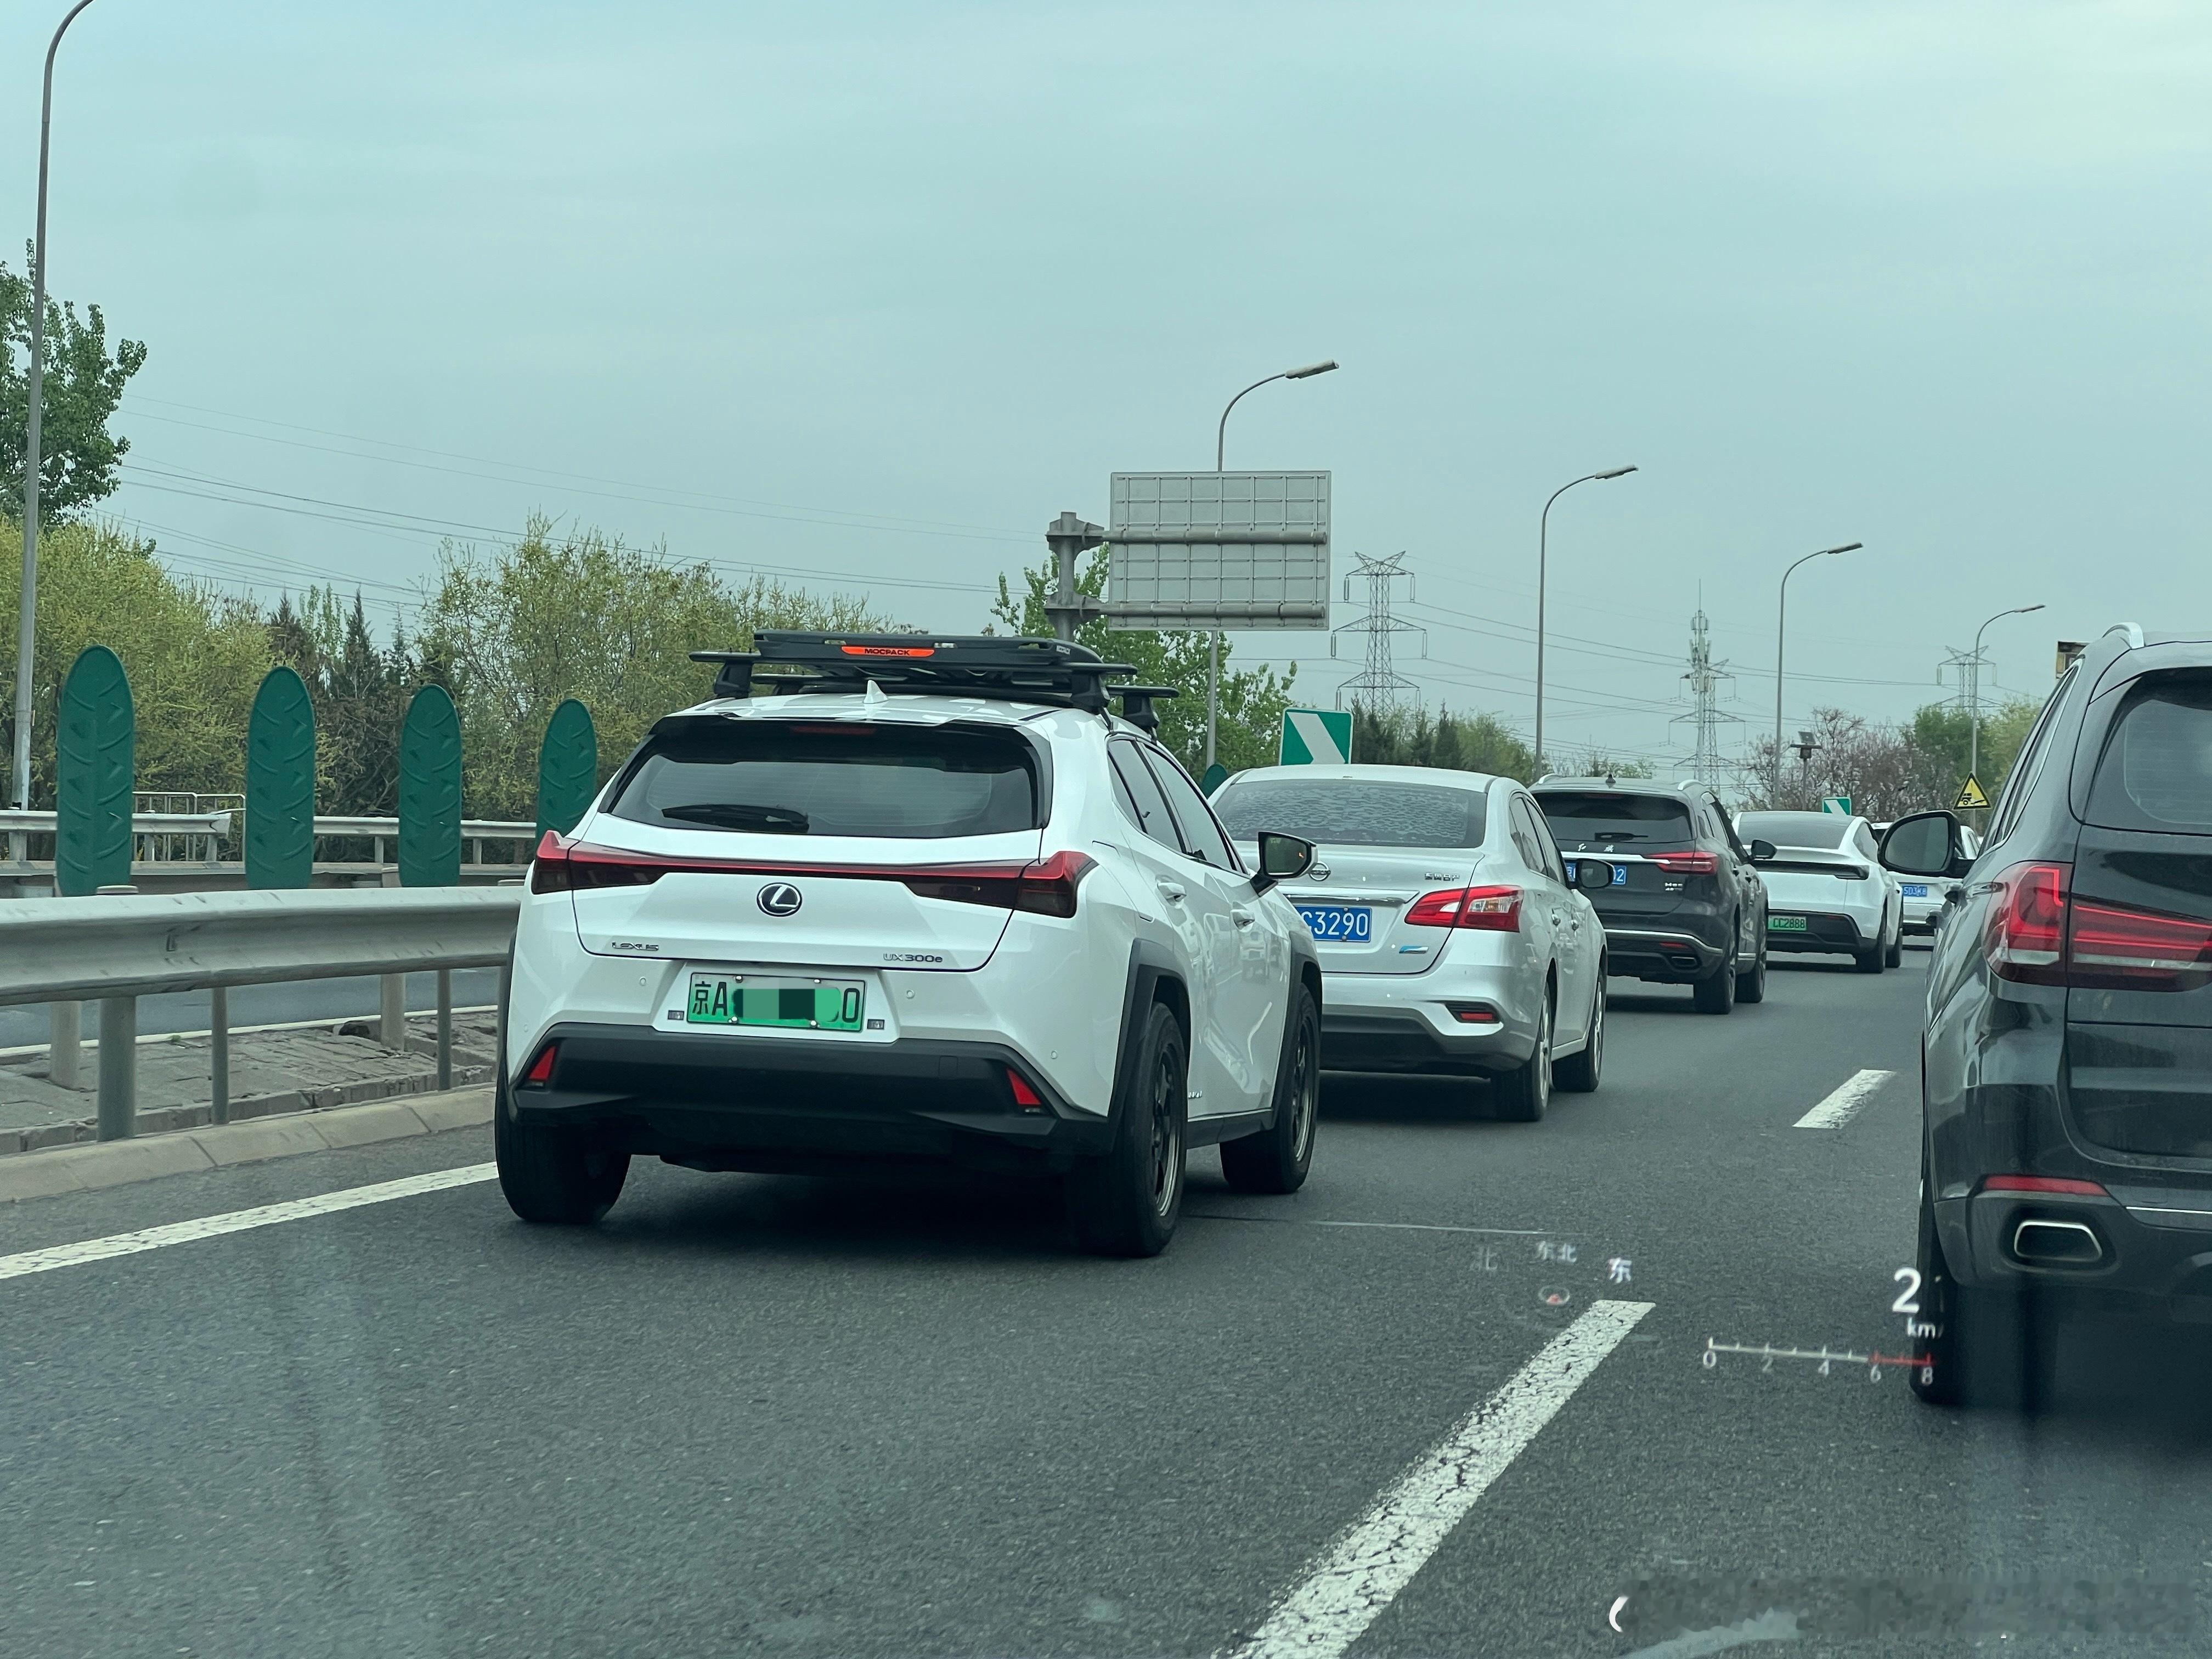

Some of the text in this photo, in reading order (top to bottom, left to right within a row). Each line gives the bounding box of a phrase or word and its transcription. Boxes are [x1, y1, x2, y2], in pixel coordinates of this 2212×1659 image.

[612, 941, 659, 951] LEXUS
[883, 953, 943, 963] UX300e
[1609, 1256, 1632, 1283] 东
[1703, 1350, 1717, 1368] 0
[1818, 1359, 1829, 1376] 4
[1870, 1364, 1882, 1383] 6
[1922, 1367, 1933, 1385] 8
